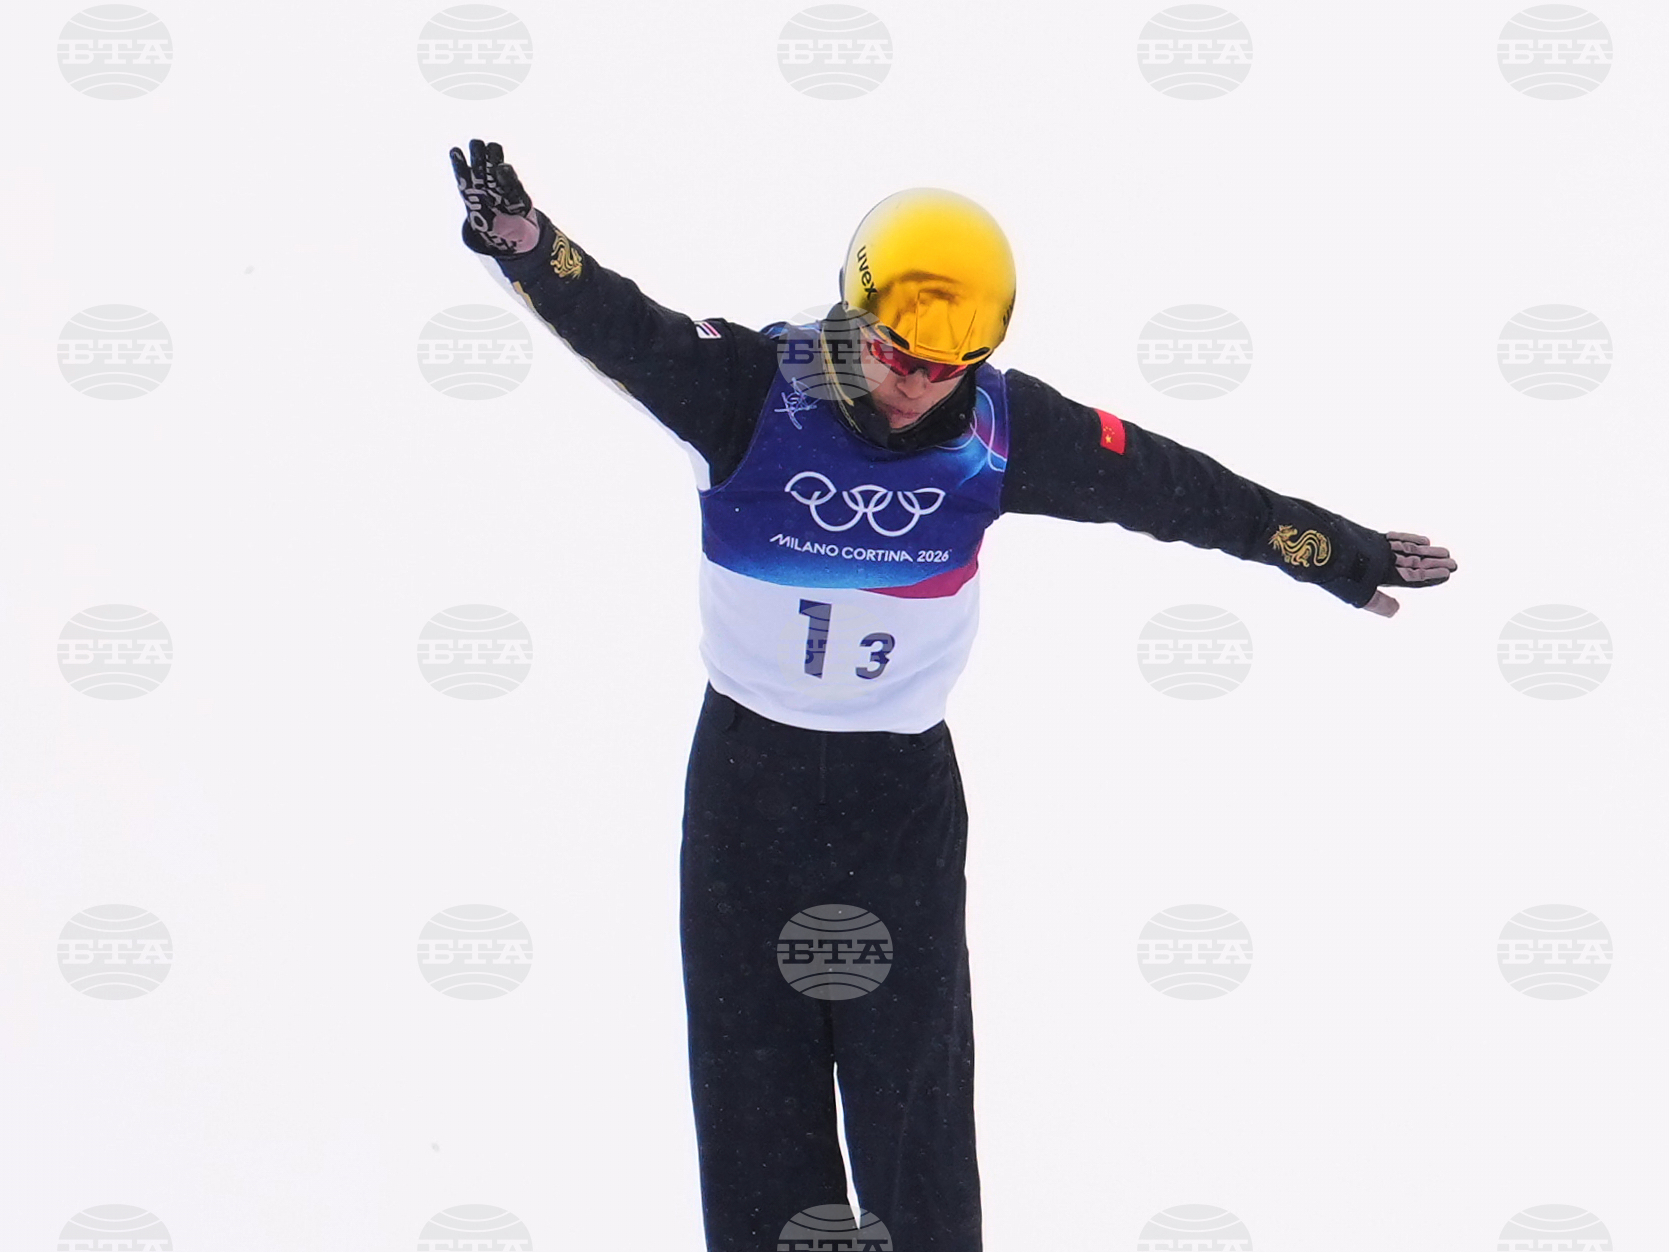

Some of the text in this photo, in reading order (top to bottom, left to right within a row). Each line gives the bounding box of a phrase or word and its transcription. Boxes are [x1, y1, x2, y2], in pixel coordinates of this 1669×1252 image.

[857, 244, 878, 300] uvex
[769, 533, 950, 563] MILANO CORTINA 2026
[798, 598, 896, 681] 1 3
